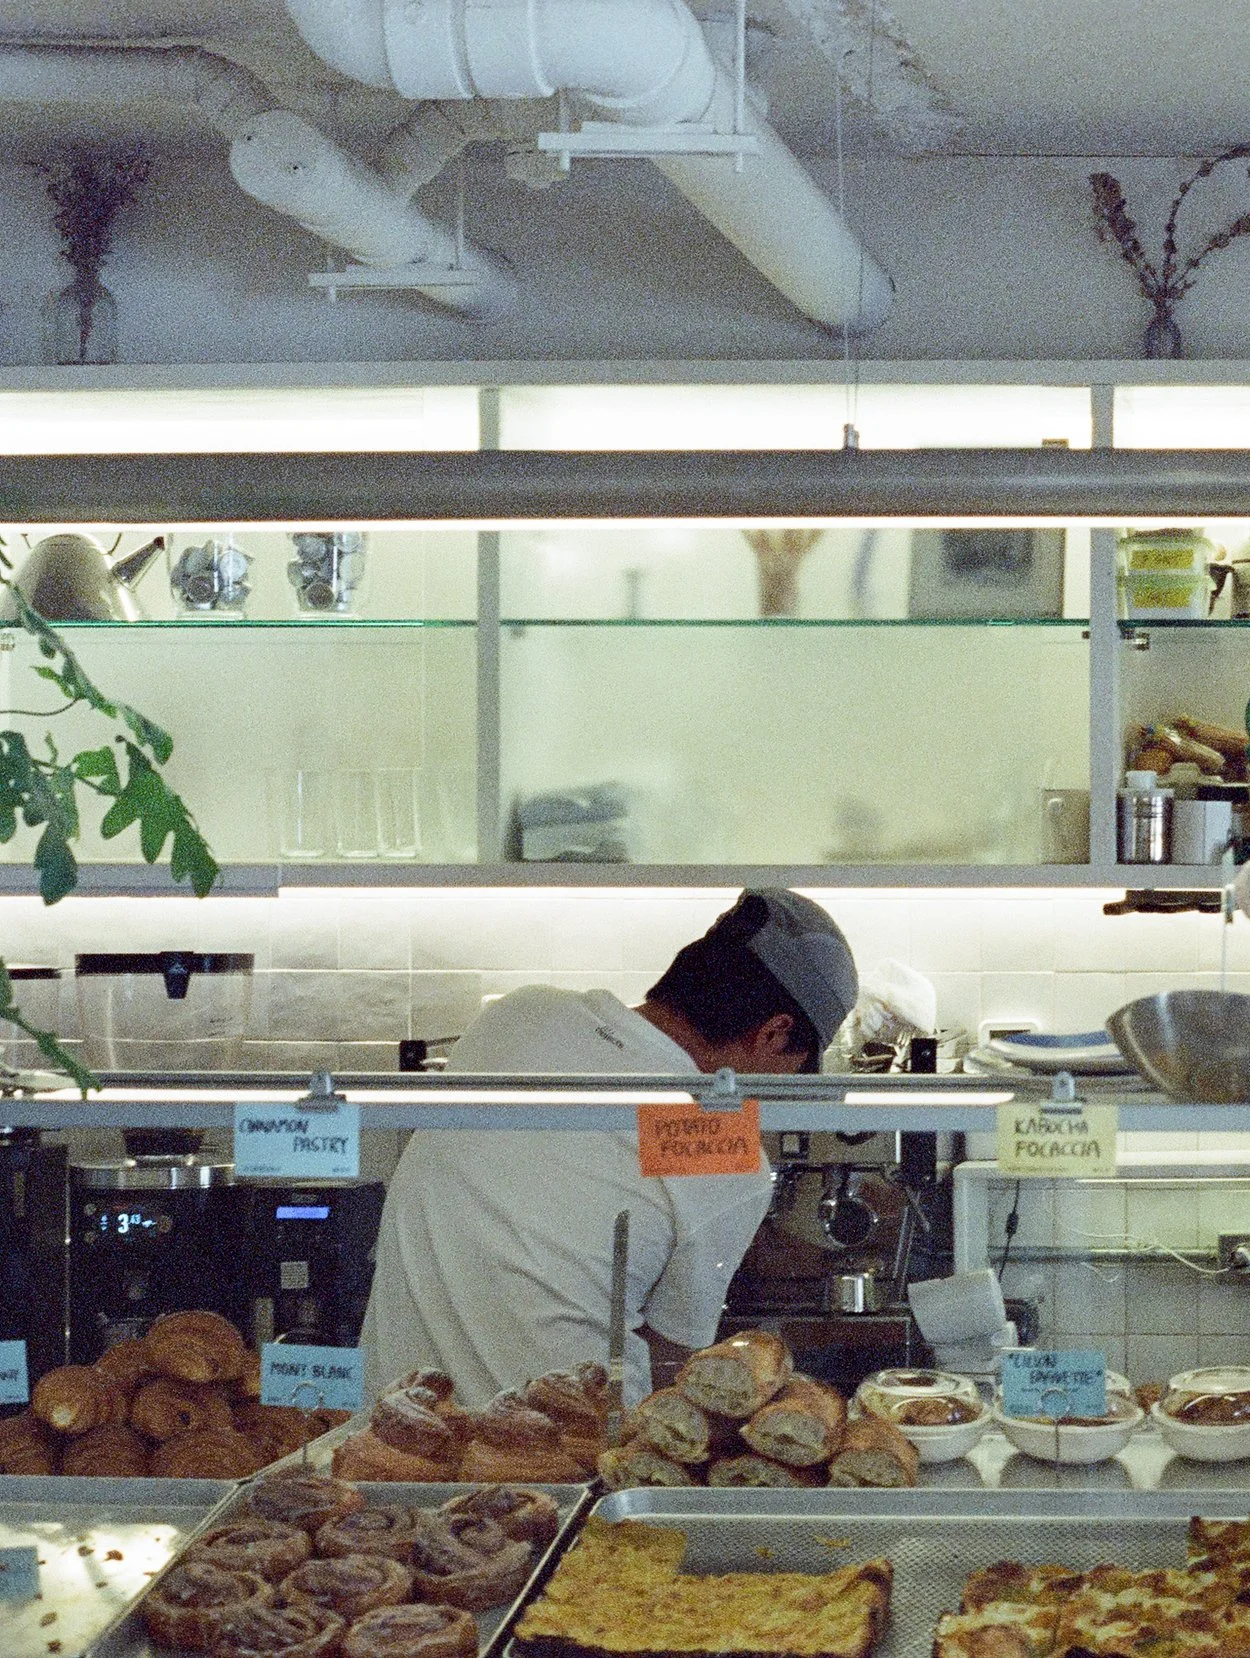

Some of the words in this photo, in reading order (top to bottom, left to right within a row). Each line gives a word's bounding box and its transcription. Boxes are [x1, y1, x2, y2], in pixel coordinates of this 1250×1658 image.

[655, 1118, 721, 1138] POTATO
[1014, 1117, 1089, 1135] KABOCHA
[292, 1136, 349, 1154] PASTRY
[660, 1136, 749, 1158] FOCACCIA
[1014, 1139, 1101, 1159] FOCACCIA
